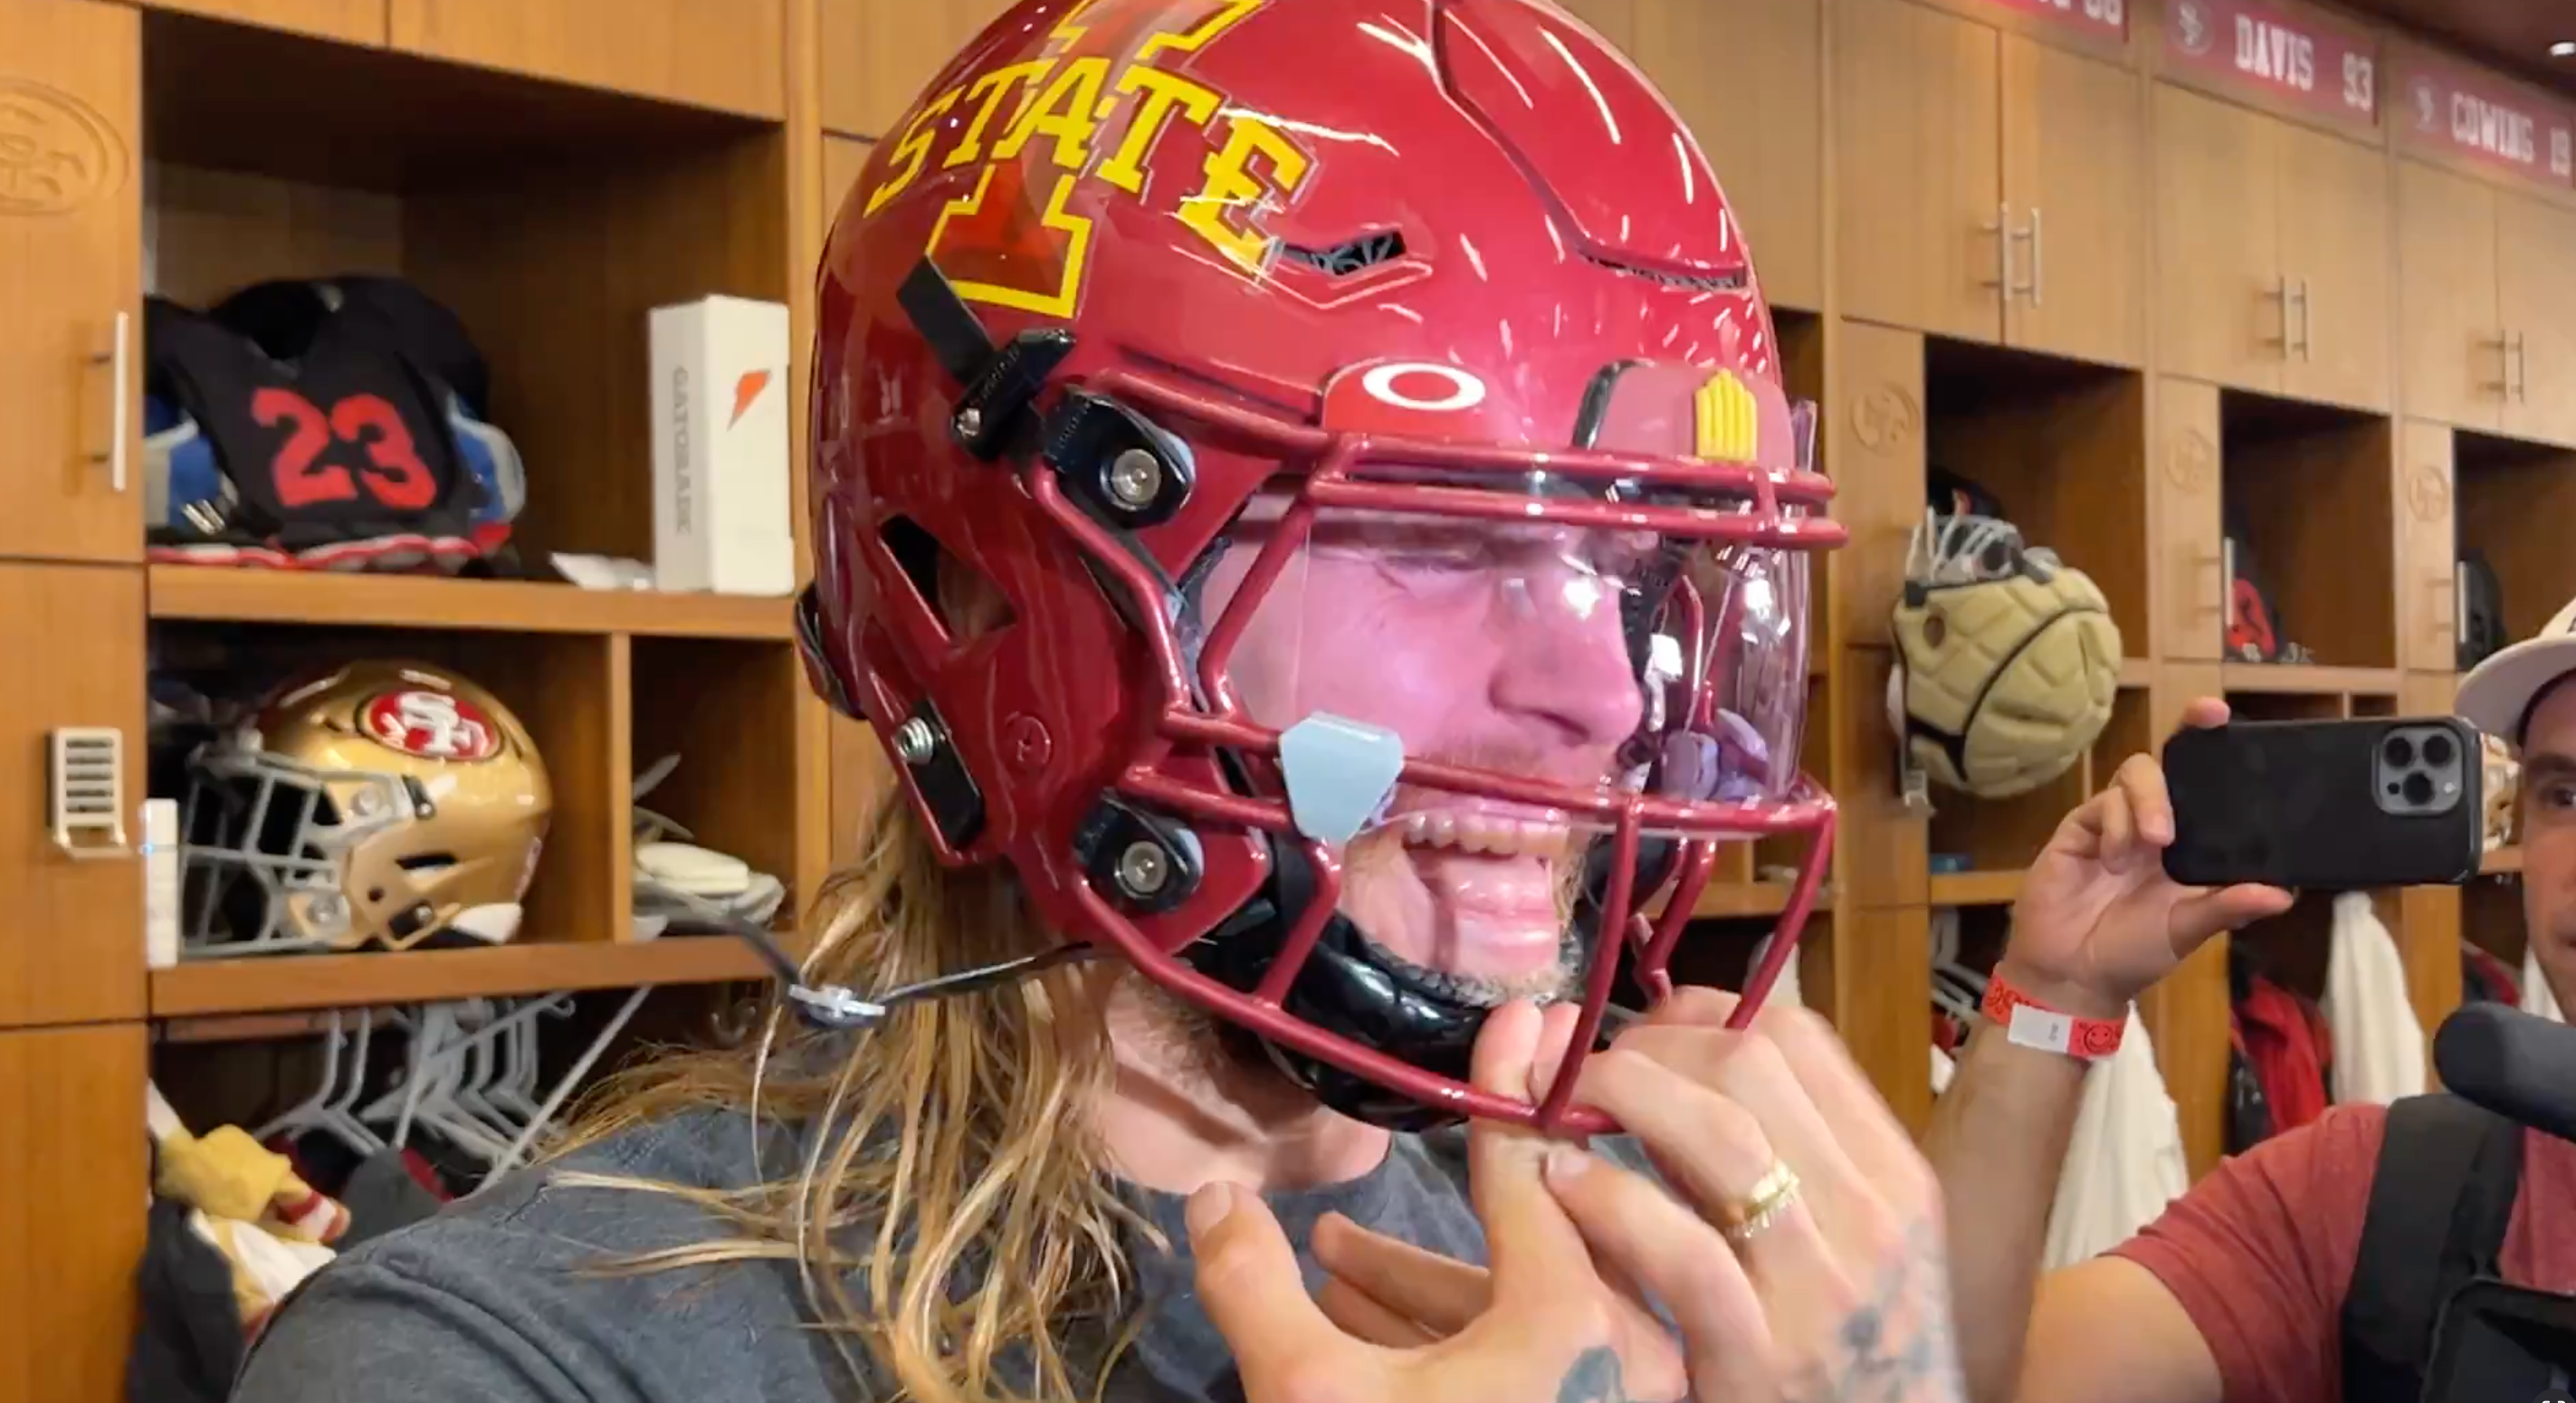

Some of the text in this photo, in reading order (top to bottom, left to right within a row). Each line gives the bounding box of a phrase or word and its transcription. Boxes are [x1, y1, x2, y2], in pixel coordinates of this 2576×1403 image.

[2235, 14, 2314, 91] DAVIS
[2342, 52, 2373, 111] 93
[863, 57, 1307, 274] STATE
[2450, 91, 2535, 164] COWING
[253, 387, 437, 511] 23
[673, 367, 691, 535] GATORADE
